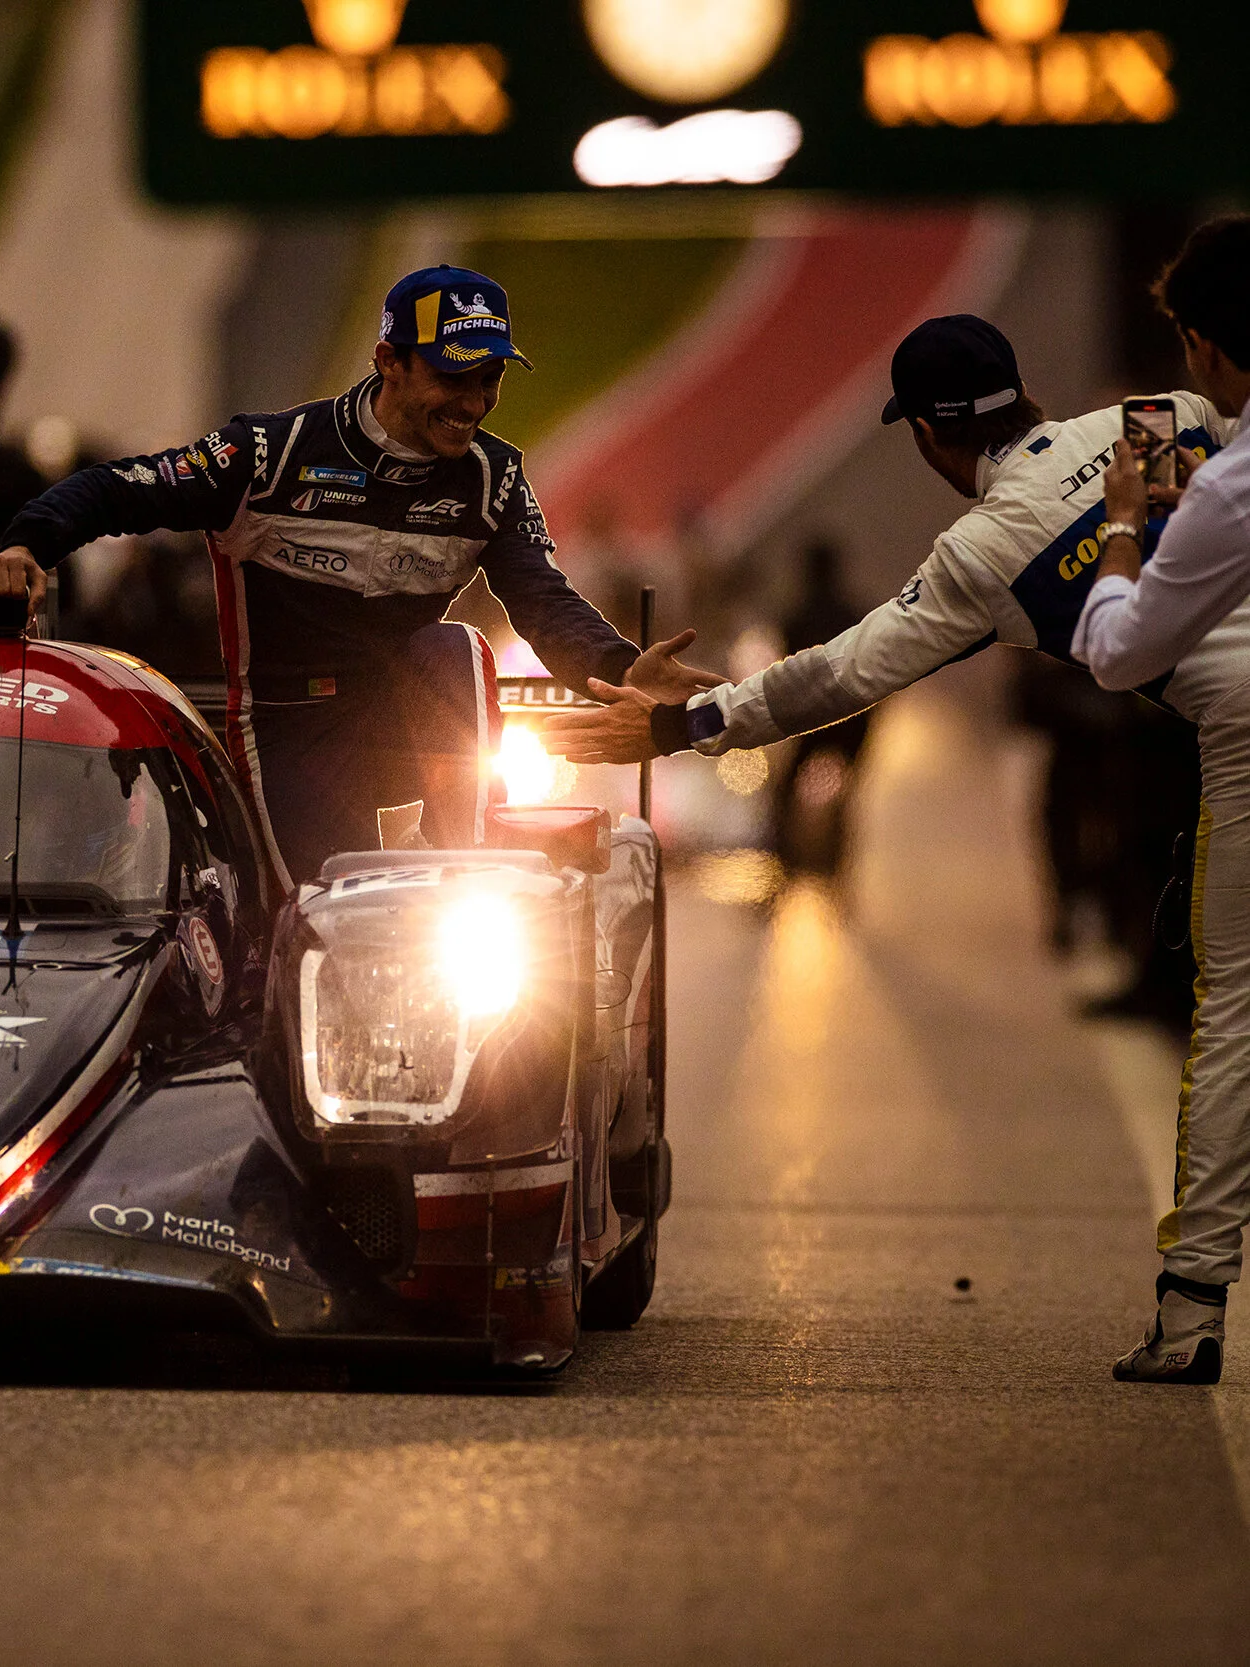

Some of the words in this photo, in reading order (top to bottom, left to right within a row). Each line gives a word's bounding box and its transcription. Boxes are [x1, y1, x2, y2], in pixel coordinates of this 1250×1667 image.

[442, 318, 507, 335] MICHELIN
[252, 426, 269, 482] HRX
[318, 472, 360, 482] MICHELIN
[492, 456, 518, 512] HRX
[324, 490, 367, 503] UNITED
[273, 548, 348, 572] AERO
[499, 686, 590, 705] FLU
[163, 1211, 236, 1237] Maria
[160, 1224, 291, 1272] Mallaband
